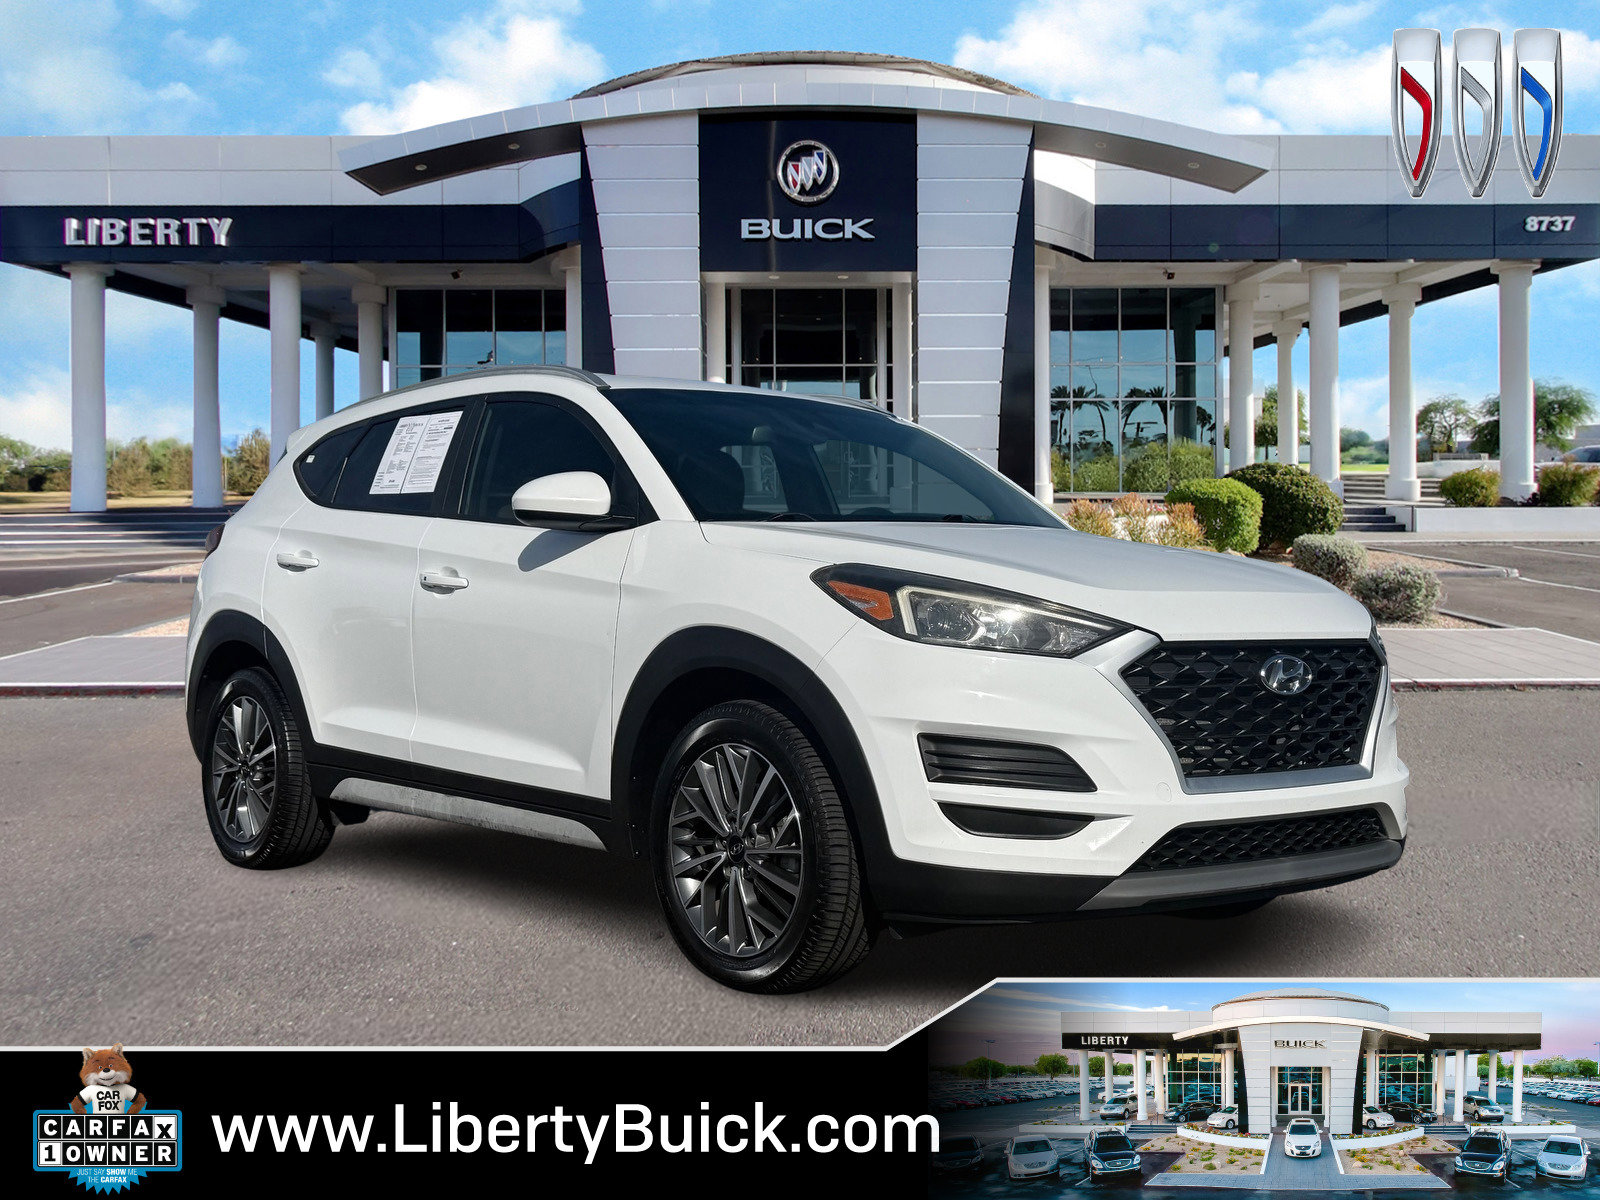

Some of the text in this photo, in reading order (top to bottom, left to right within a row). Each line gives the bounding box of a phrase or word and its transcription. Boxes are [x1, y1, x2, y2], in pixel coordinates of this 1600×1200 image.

[64, 217, 233, 247] LIBERTY
[740, 218, 876, 240] BUICK
[1524, 215, 1576, 233] 8737
